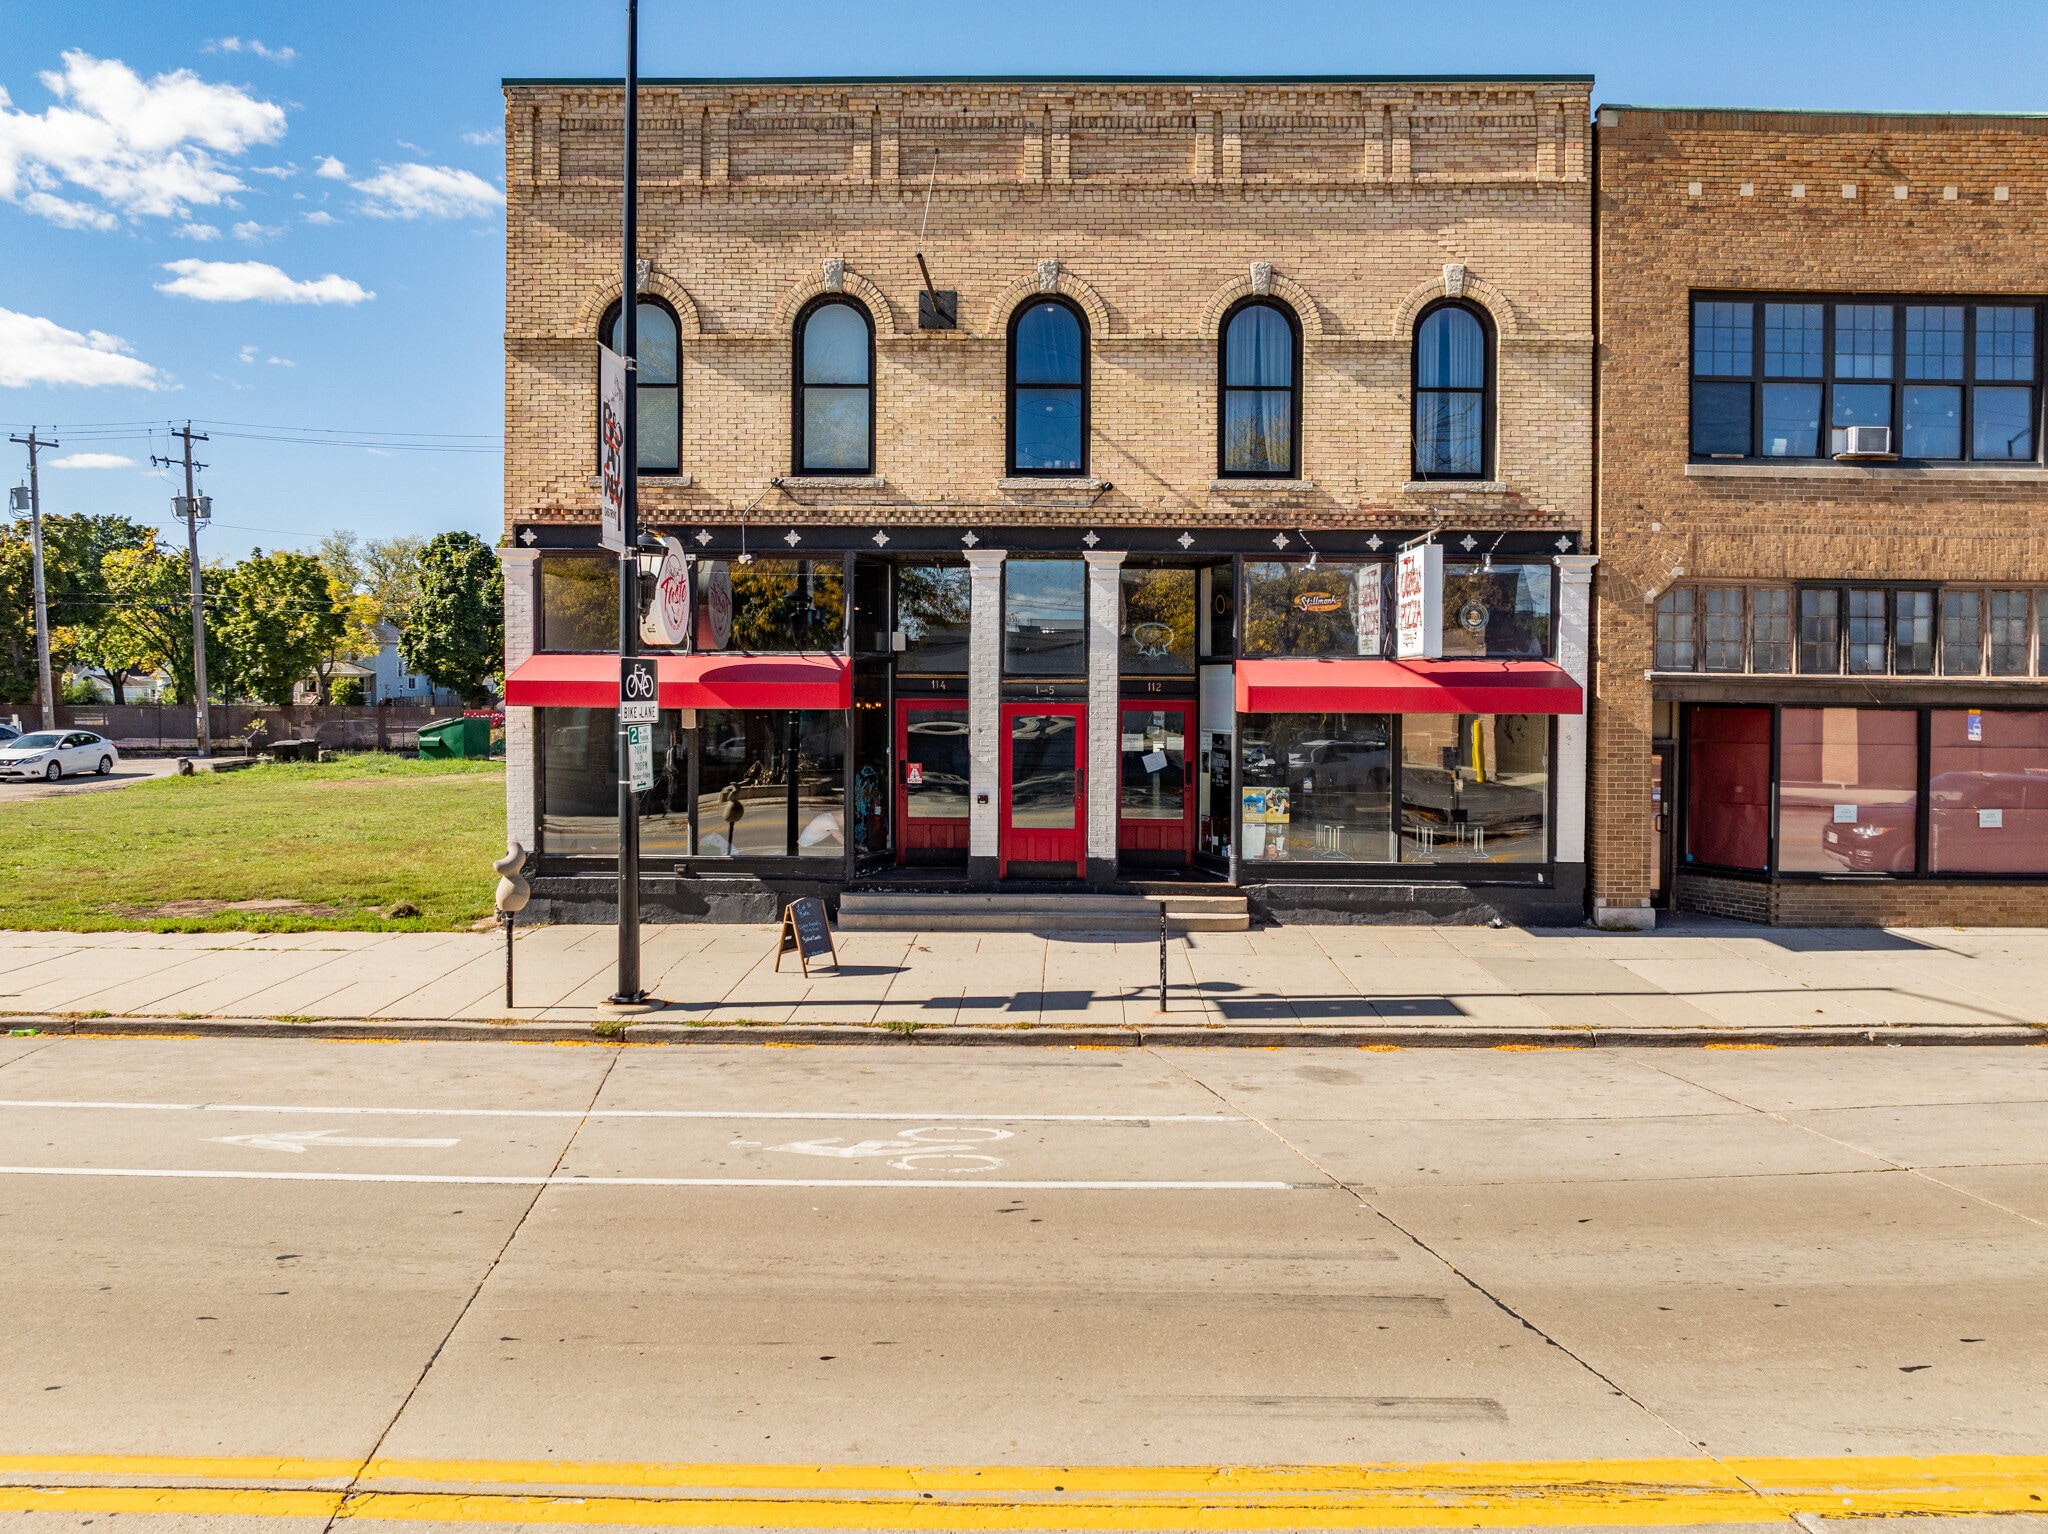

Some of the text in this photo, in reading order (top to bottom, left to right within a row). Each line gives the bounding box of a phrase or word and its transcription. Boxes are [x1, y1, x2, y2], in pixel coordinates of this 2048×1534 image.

[660, 574, 687, 612] Taste
[931, 680, 946, 690] 114
[1147, 682, 1162, 692] 112
[624, 706, 656, 719] BIKE LANE
[630, 727, 638, 743] 2
